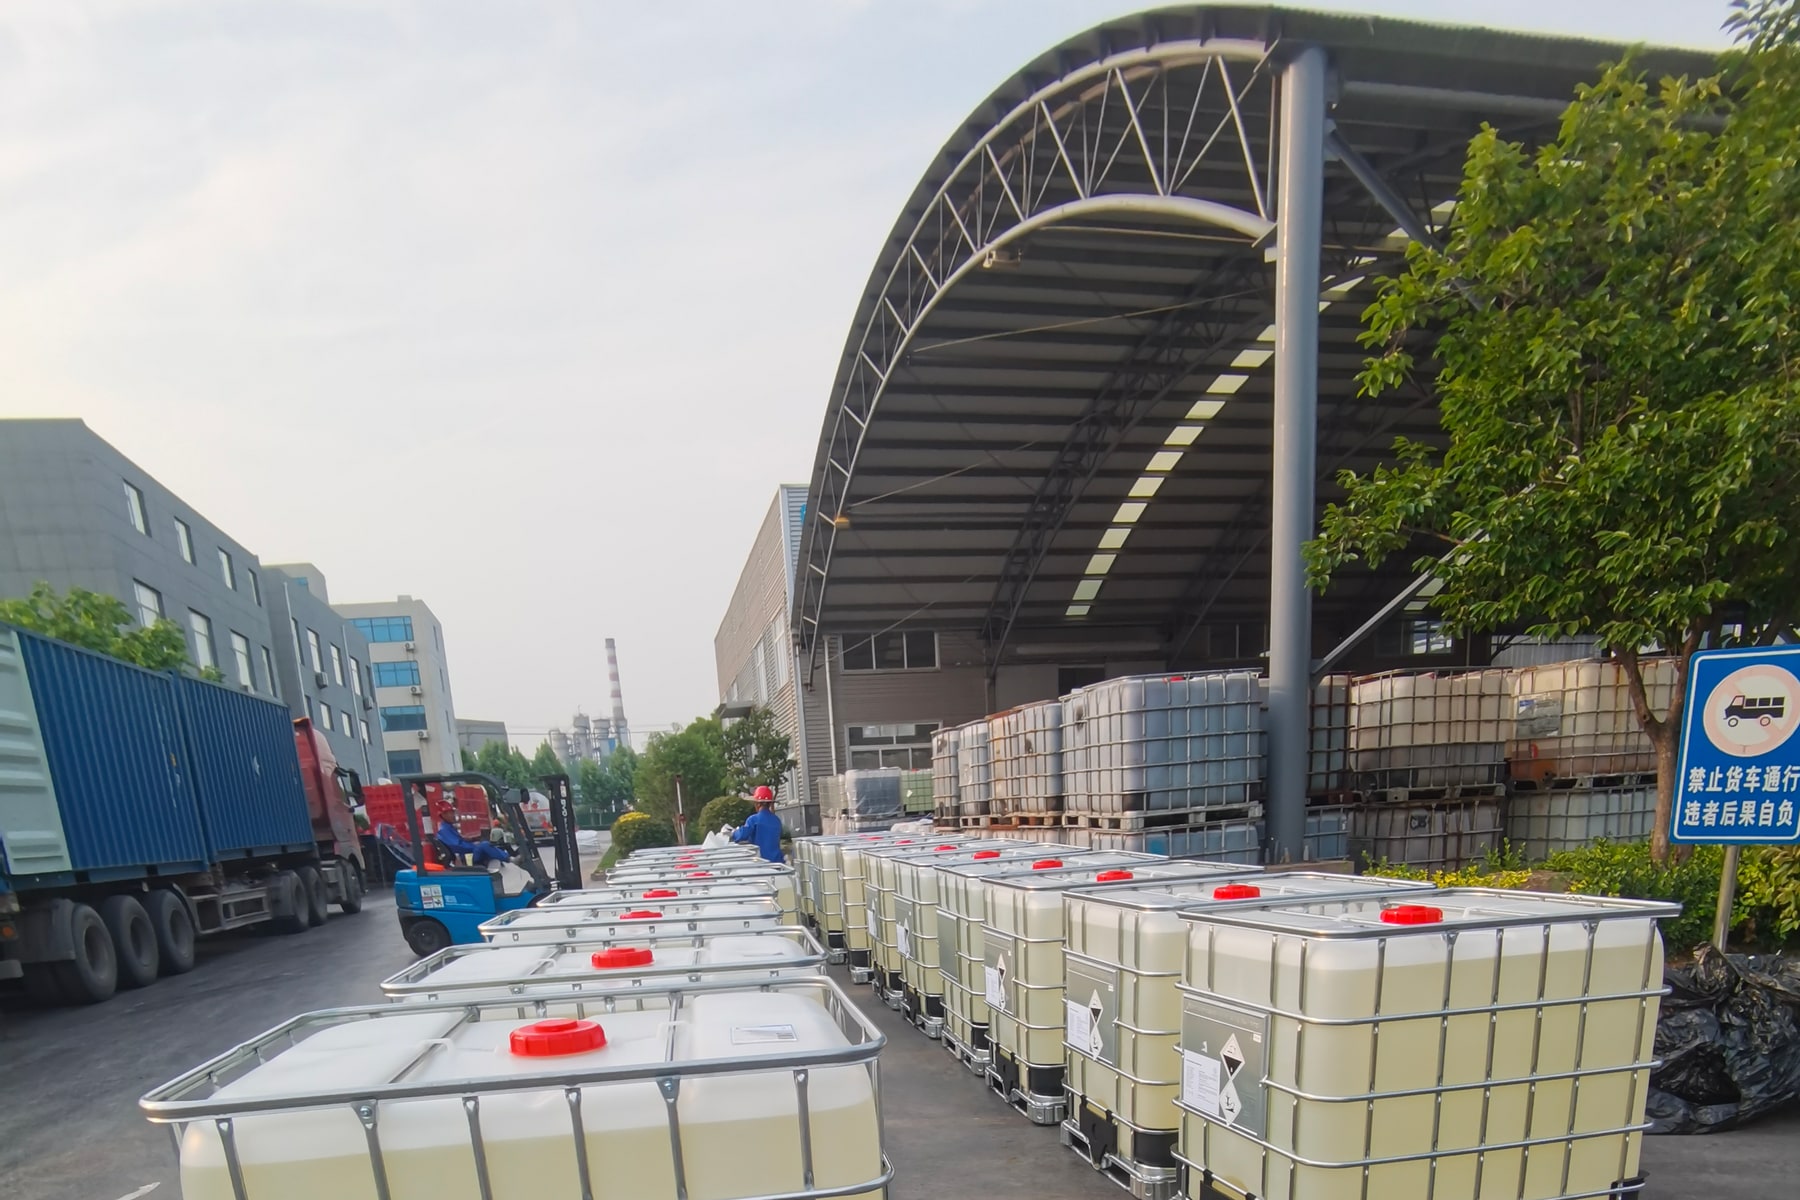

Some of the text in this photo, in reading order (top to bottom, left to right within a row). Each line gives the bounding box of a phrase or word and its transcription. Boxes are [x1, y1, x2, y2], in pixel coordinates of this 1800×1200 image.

[1688, 766, 1800, 793] 禁止货车通行
[1683, 800, 1793, 827] 违者后果自负
